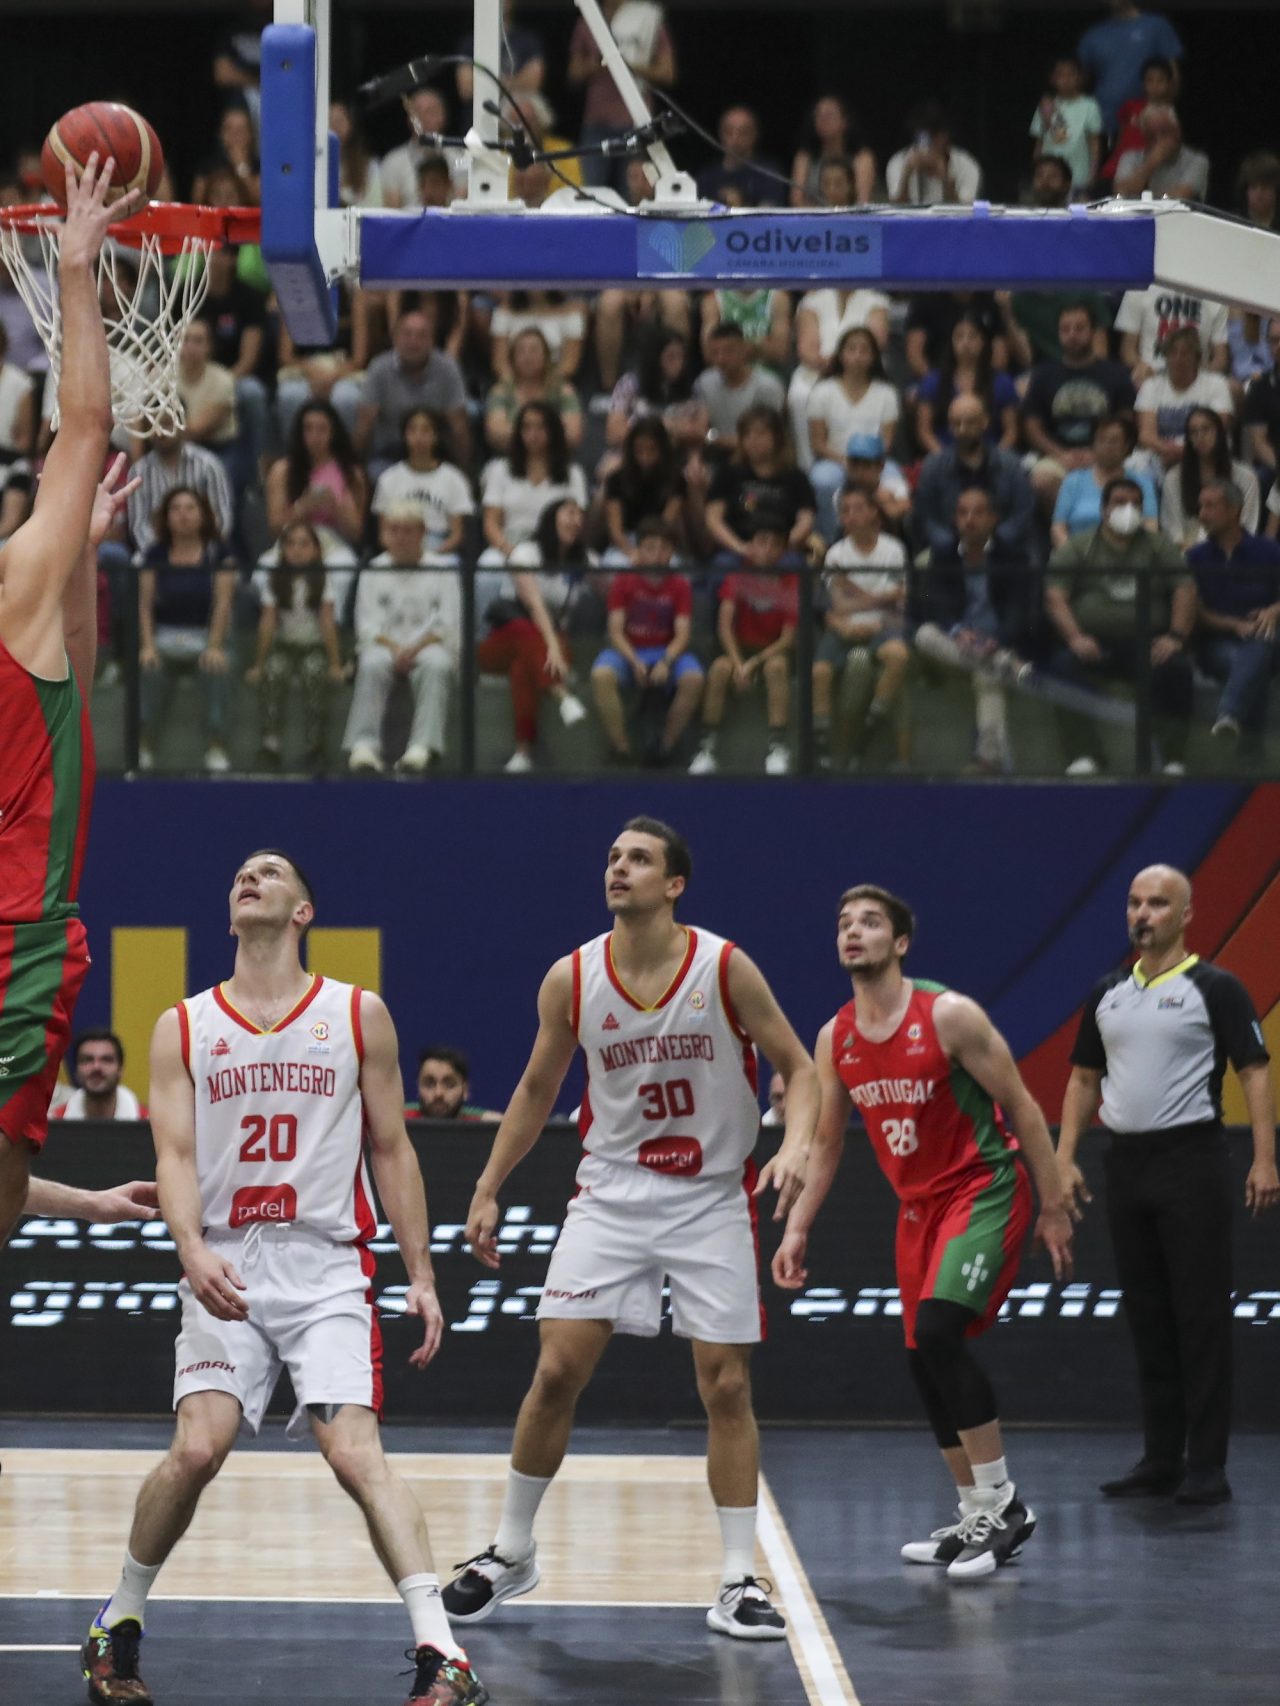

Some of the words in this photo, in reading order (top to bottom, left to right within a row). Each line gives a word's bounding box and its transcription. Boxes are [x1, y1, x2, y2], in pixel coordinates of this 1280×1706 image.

[725, 229, 870, 254] Odivelas
[598, 1034, 715, 1072] MONTENEGRO
[207, 1062, 336, 1104] MONTENEGRO
[638, 1078, 695, 1120] 30
[239, 1114, 298, 1162] 20
[881, 1118, 919, 1157] 28
